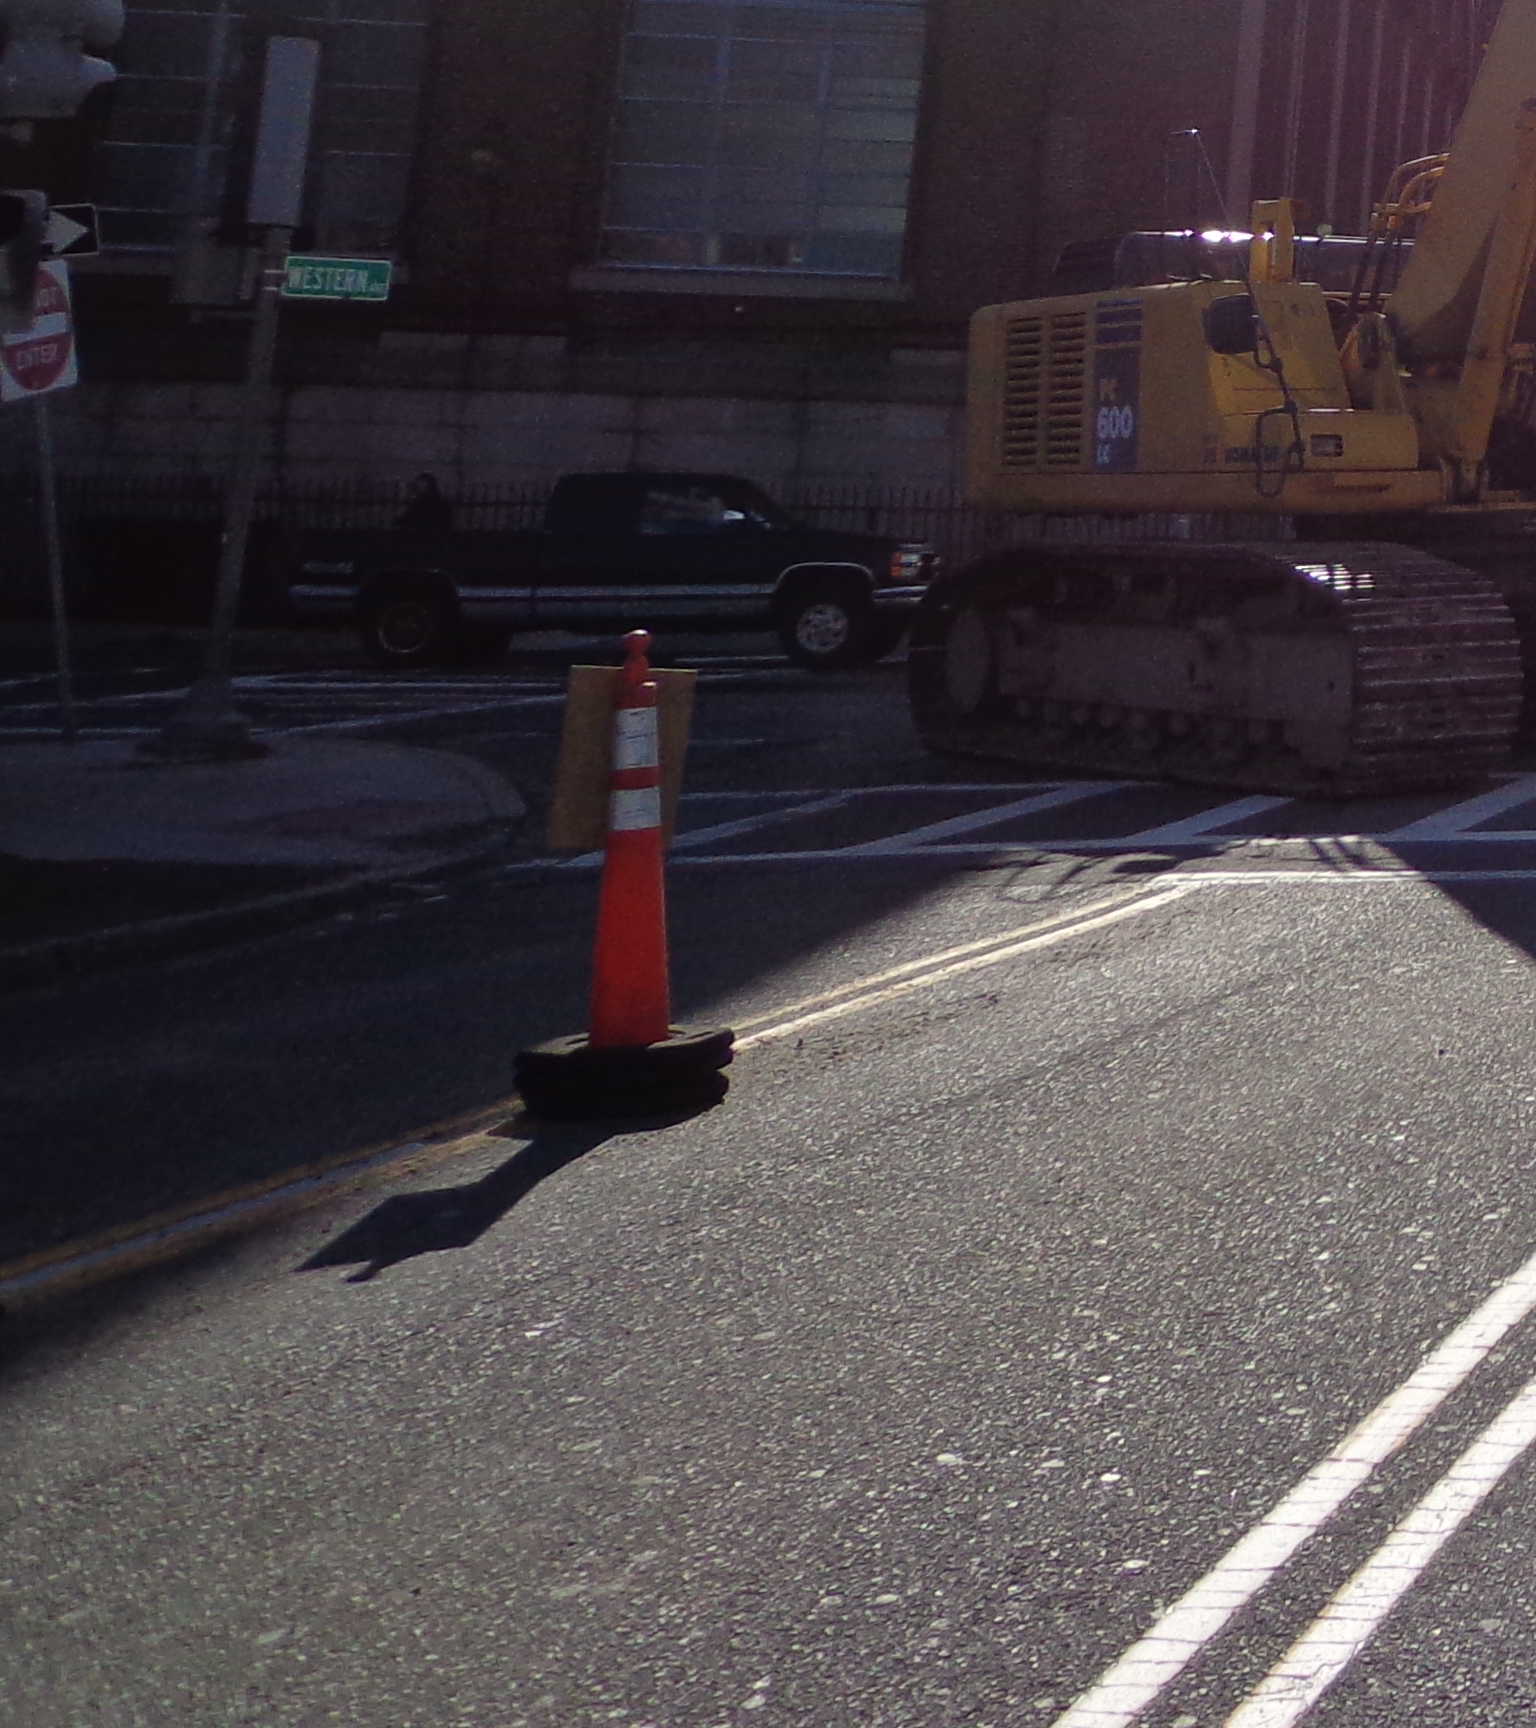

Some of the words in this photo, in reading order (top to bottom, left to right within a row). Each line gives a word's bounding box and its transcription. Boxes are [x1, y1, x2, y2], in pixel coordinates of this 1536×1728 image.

[288, 266, 368, 292] WESTERN
[16, 343, 58, 370] ENTER
[1096, 405, 1133, 438] 600
